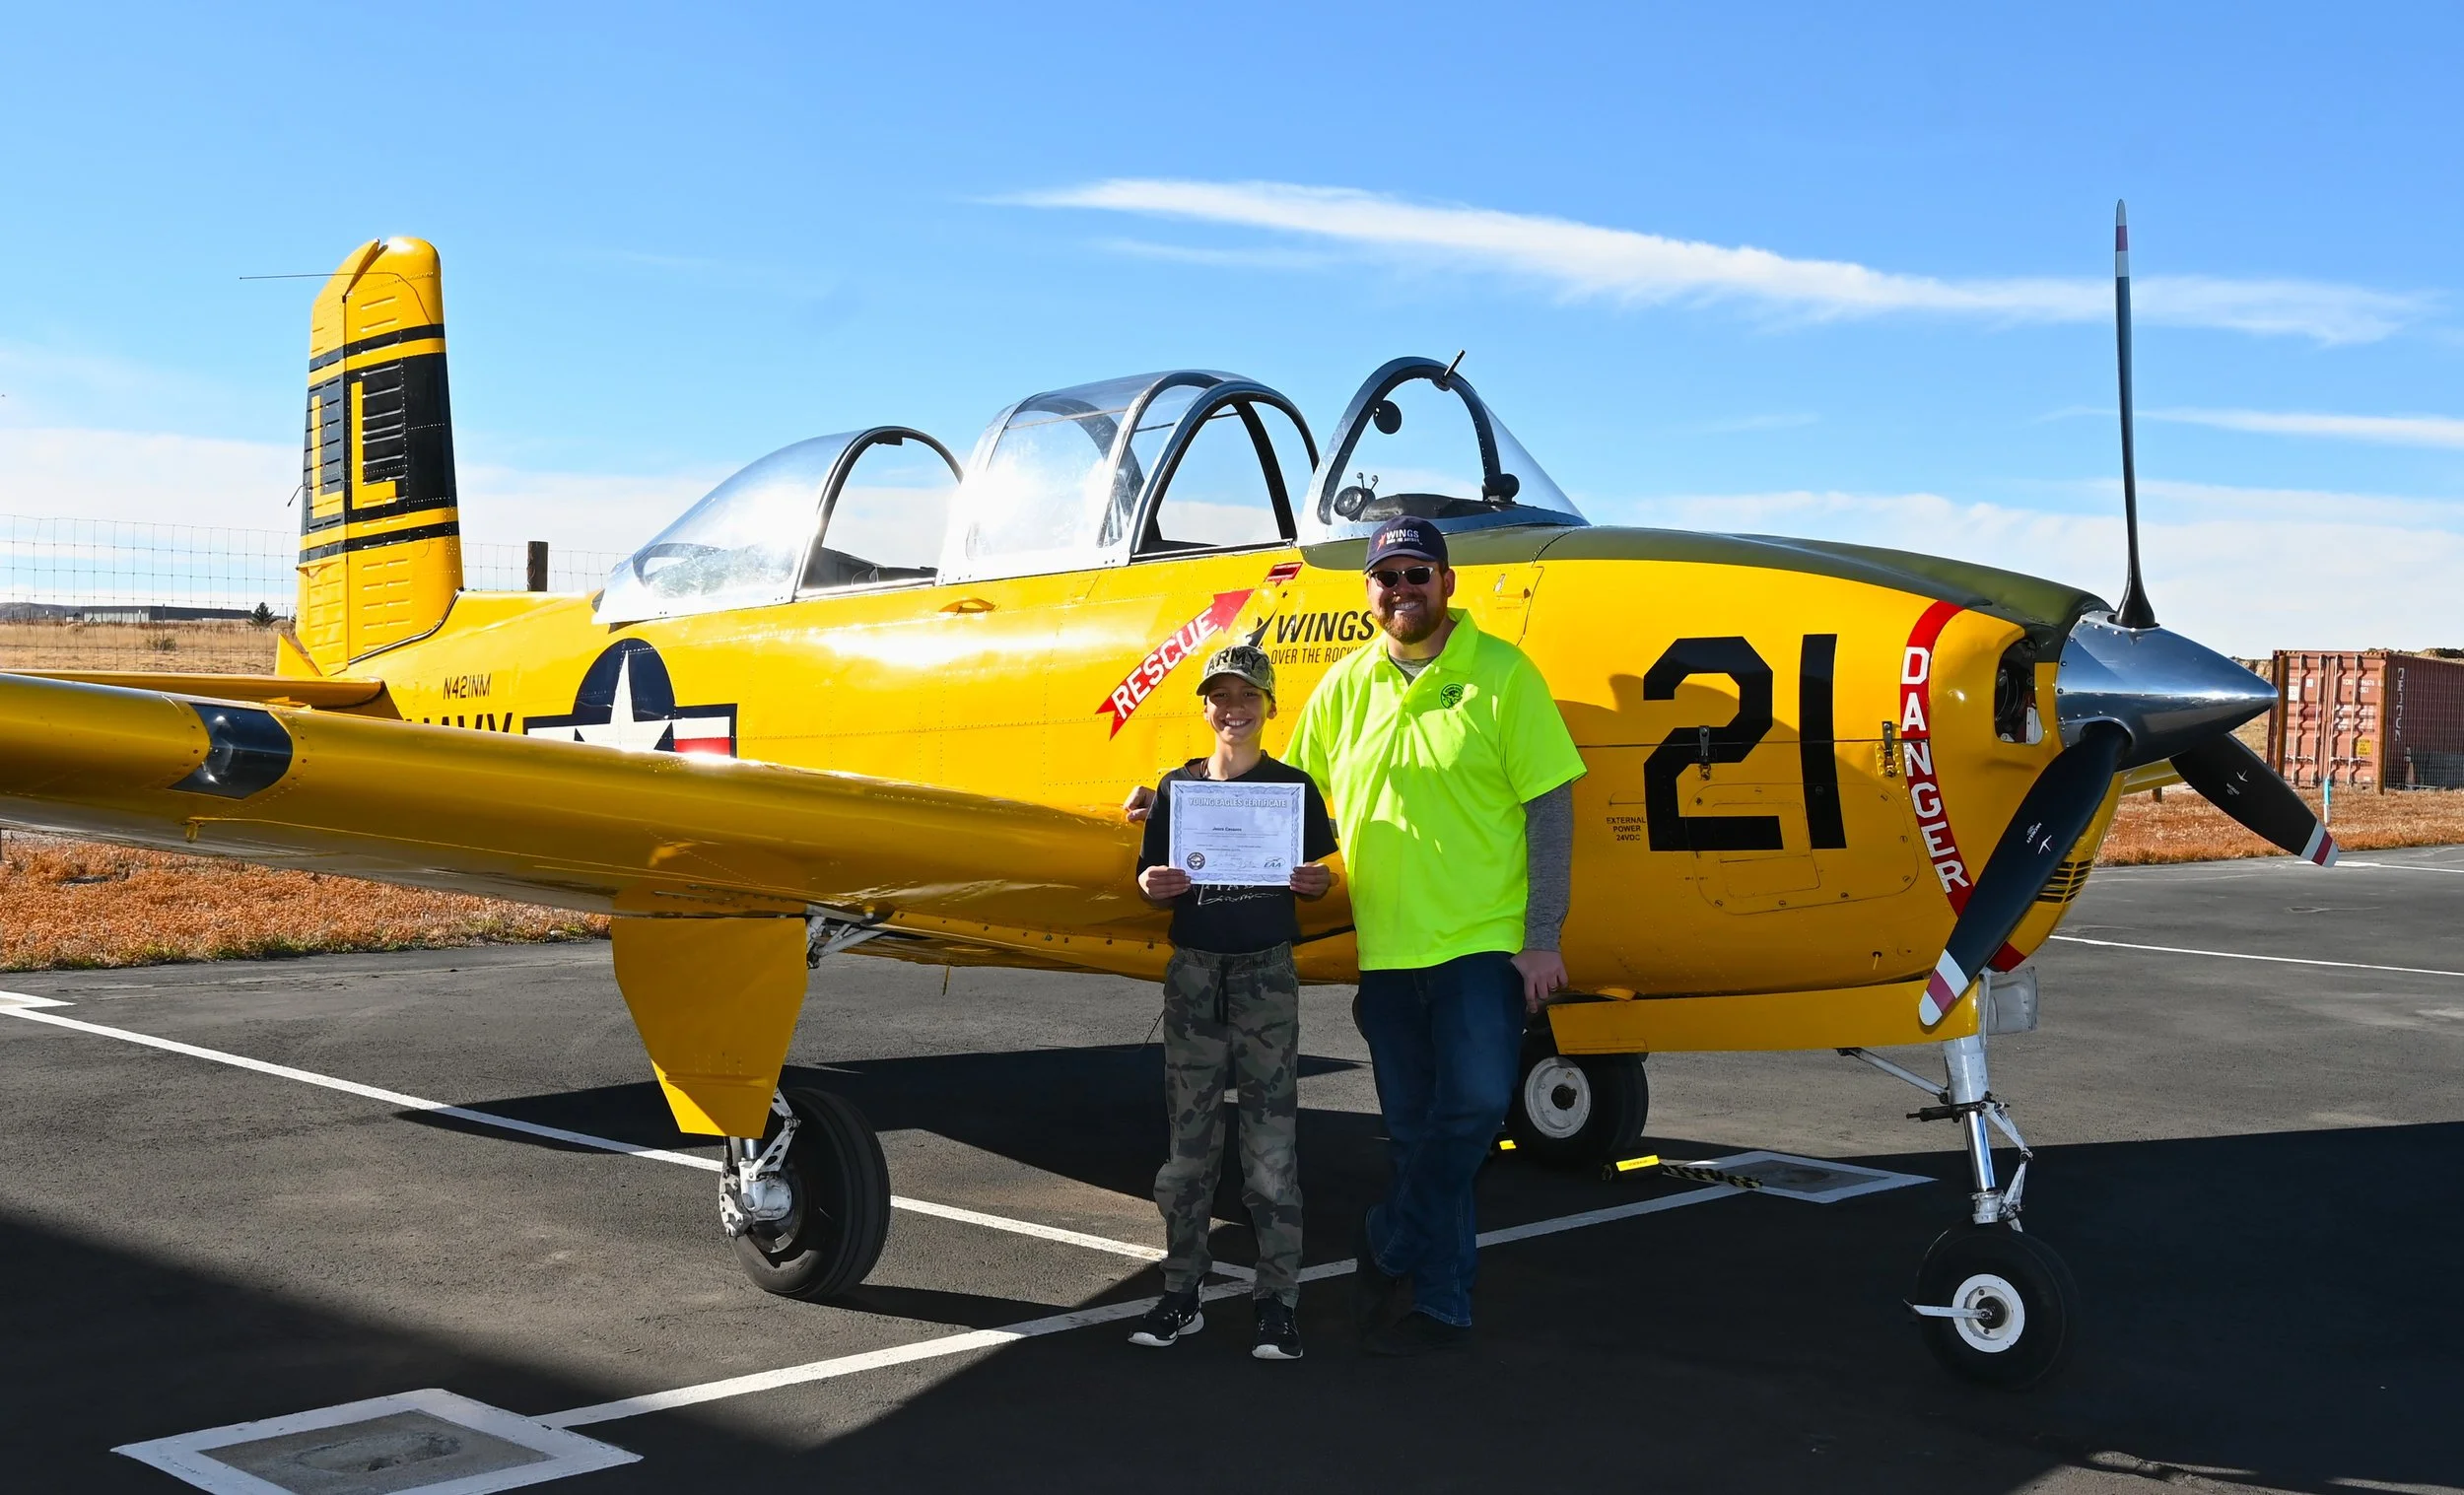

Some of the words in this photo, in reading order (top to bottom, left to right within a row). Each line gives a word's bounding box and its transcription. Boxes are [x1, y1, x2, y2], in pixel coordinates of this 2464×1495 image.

[1386, 529, 1419, 540] WINGS
[1276, 610, 1375, 644] WINGS
[1111, 607, 1218, 720] RESCUE
[1207, 646, 1263, 676] ARMY
[1271, 648, 1297, 664] OVER
[1302, 647, 1322, 663] THE
[1643, 634, 1847, 851] 21
[1900, 646, 1969, 894] DANGER
[1190, 797, 1214, 806] YOUNG
[1215, 797, 1242, 807] EAGLES
[1244, 798, 1287, 808] CERTIFICATE
